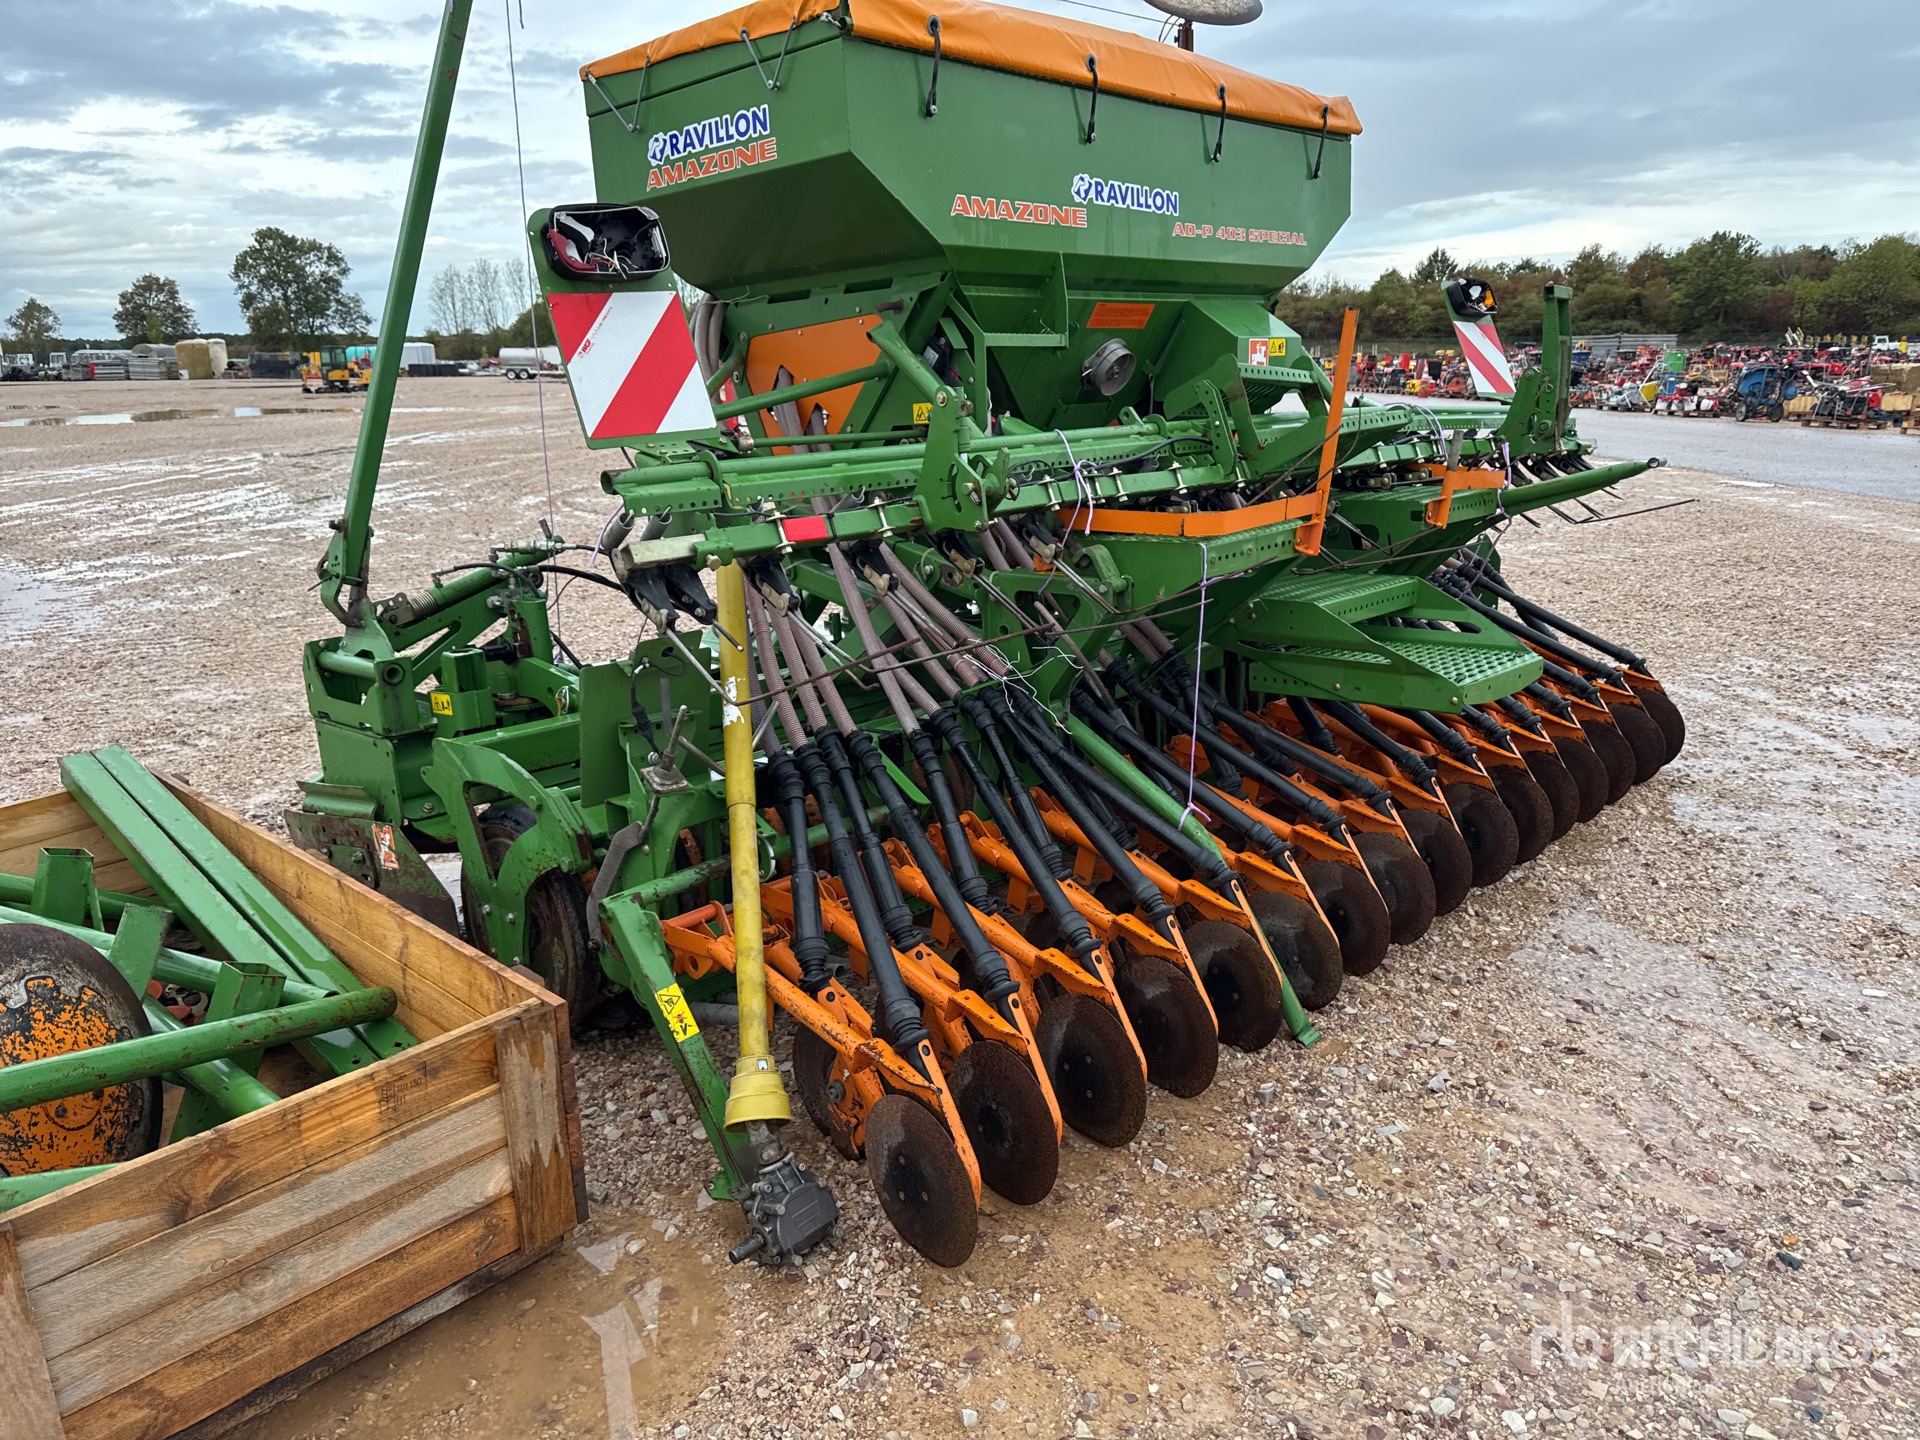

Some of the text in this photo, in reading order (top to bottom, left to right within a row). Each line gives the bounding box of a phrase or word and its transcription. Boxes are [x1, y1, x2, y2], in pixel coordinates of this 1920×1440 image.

[668, 106, 769, 157] RAVILLON
[647, 137, 777, 191] AMAZONE
[951, 194, 1087, 228] AMAZONE
[1094, 179, 1179, 215] RAVILLON
[1172, 222, 1307, 245] AD-P 403 SPECIAL
